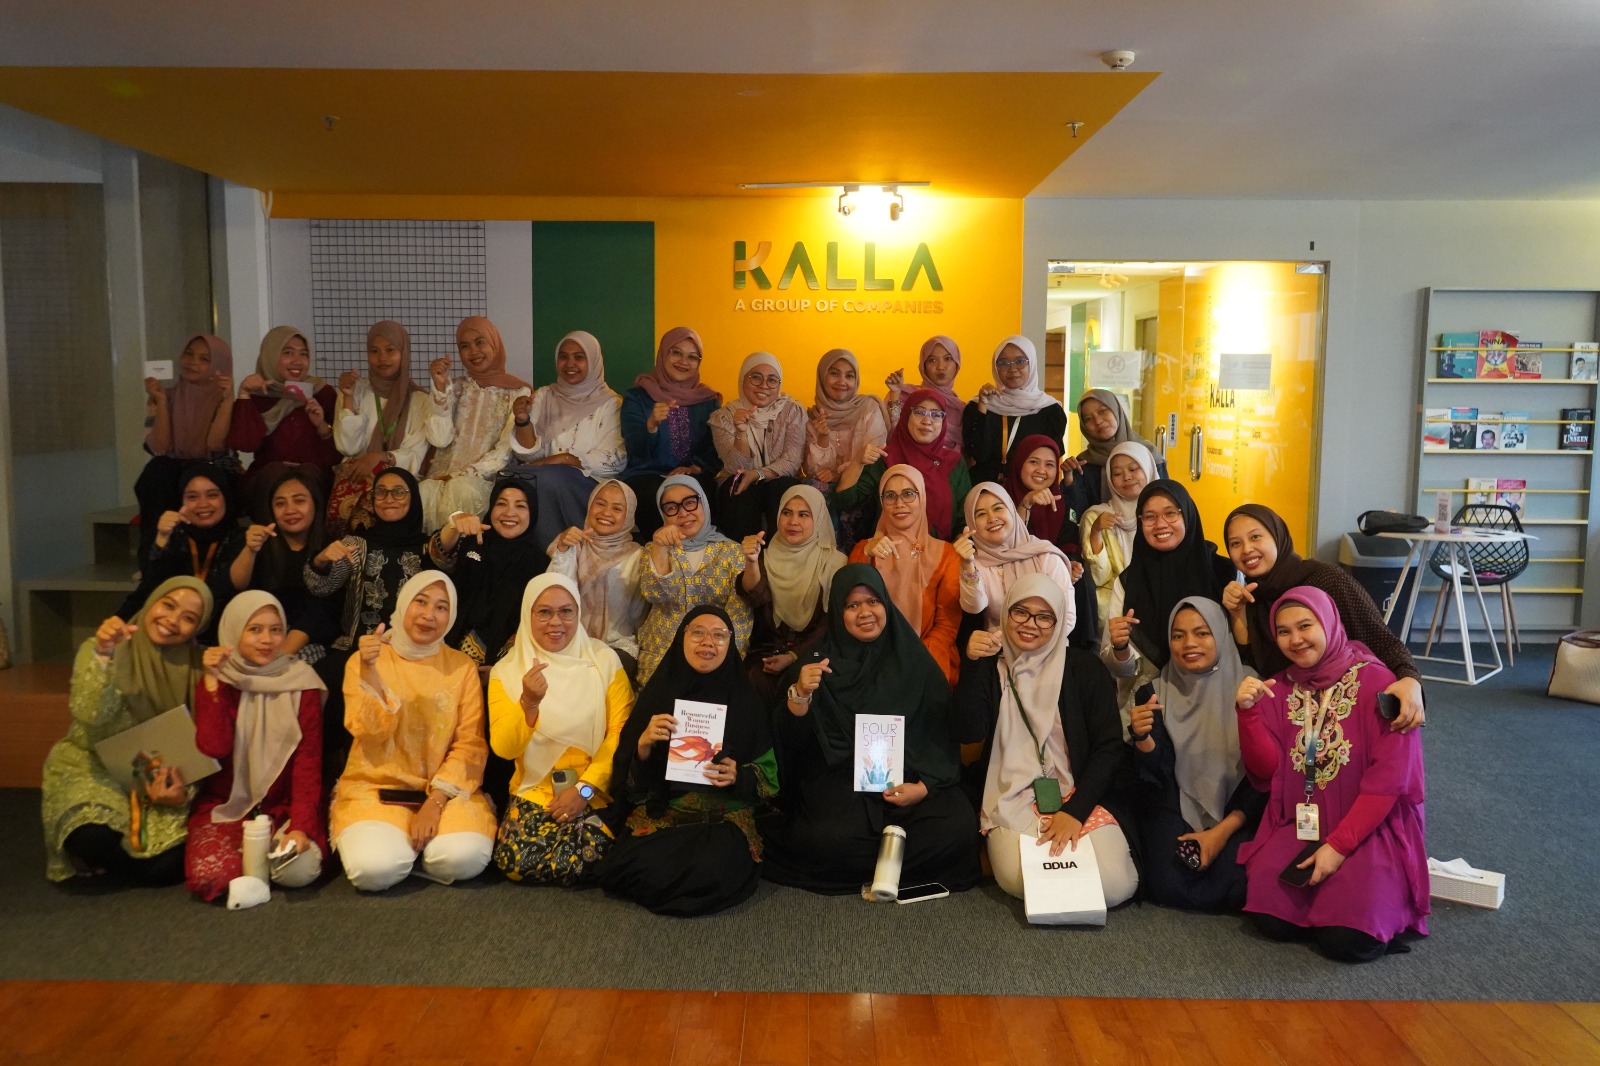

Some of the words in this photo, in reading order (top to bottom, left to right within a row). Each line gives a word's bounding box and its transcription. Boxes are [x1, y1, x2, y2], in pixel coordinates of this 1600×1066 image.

[734, 241, 944, 291] KALLA
[735, 299, 746, 311] A
[751, 299, 811, 312] GROUP
[815, 299, 838, 312] OF
[843, 299, 944, 314] COMPANIES
[1210, 383, 1235, 408] KALLA
[681, 709, 717, 720] Resourceful
[687, 716, 710, 725] Women
[684, 721, 711, 730] Business
[684, 727, 709, 735] Leaders
[862, 722, 898, 735] FOUR
[863, 735, 896, 747] SHIFT
